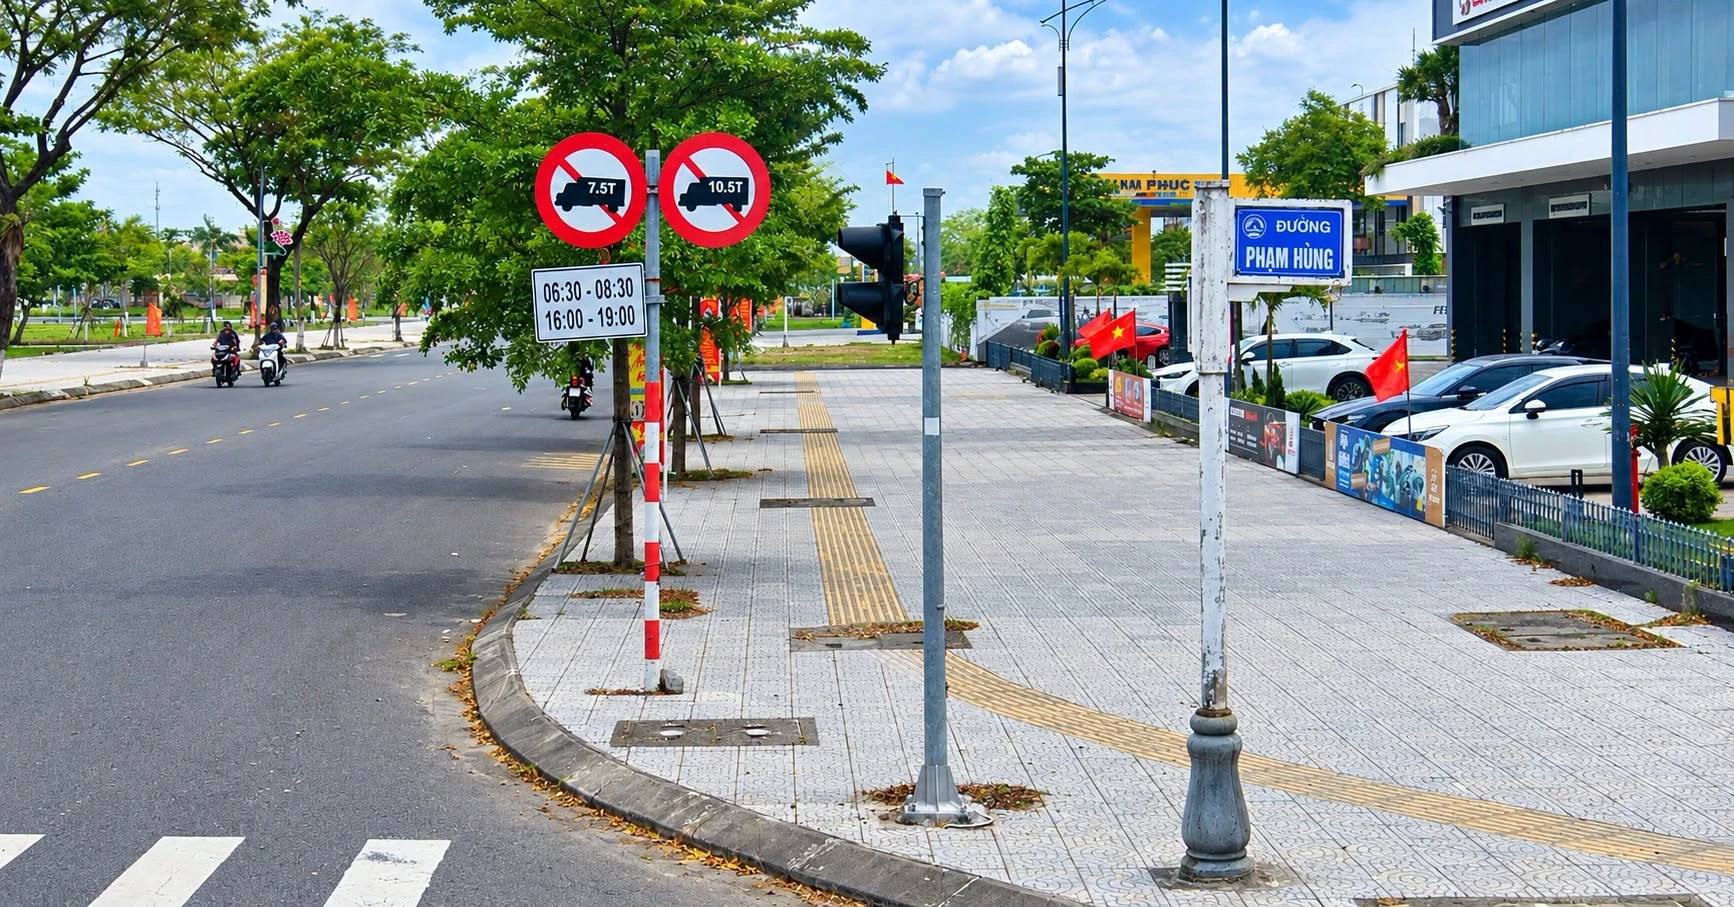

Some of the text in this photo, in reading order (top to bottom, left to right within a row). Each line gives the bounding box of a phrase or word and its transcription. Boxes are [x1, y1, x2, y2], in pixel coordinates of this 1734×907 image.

[588, 181, 616, 195] 7.5T
[708, 181, 743, 194] 10.5T
[1276, 214, 1331, 233] ĐƯỜNG
[1246, 242, 1333, 272] PHẠM HÙNG
[543, 281, 581, 303] 06:30
[595, 277, 633, 299] 08:30
[545, 308, 583, 331] 16:00
[597, 305, 635, 327] 19:00
